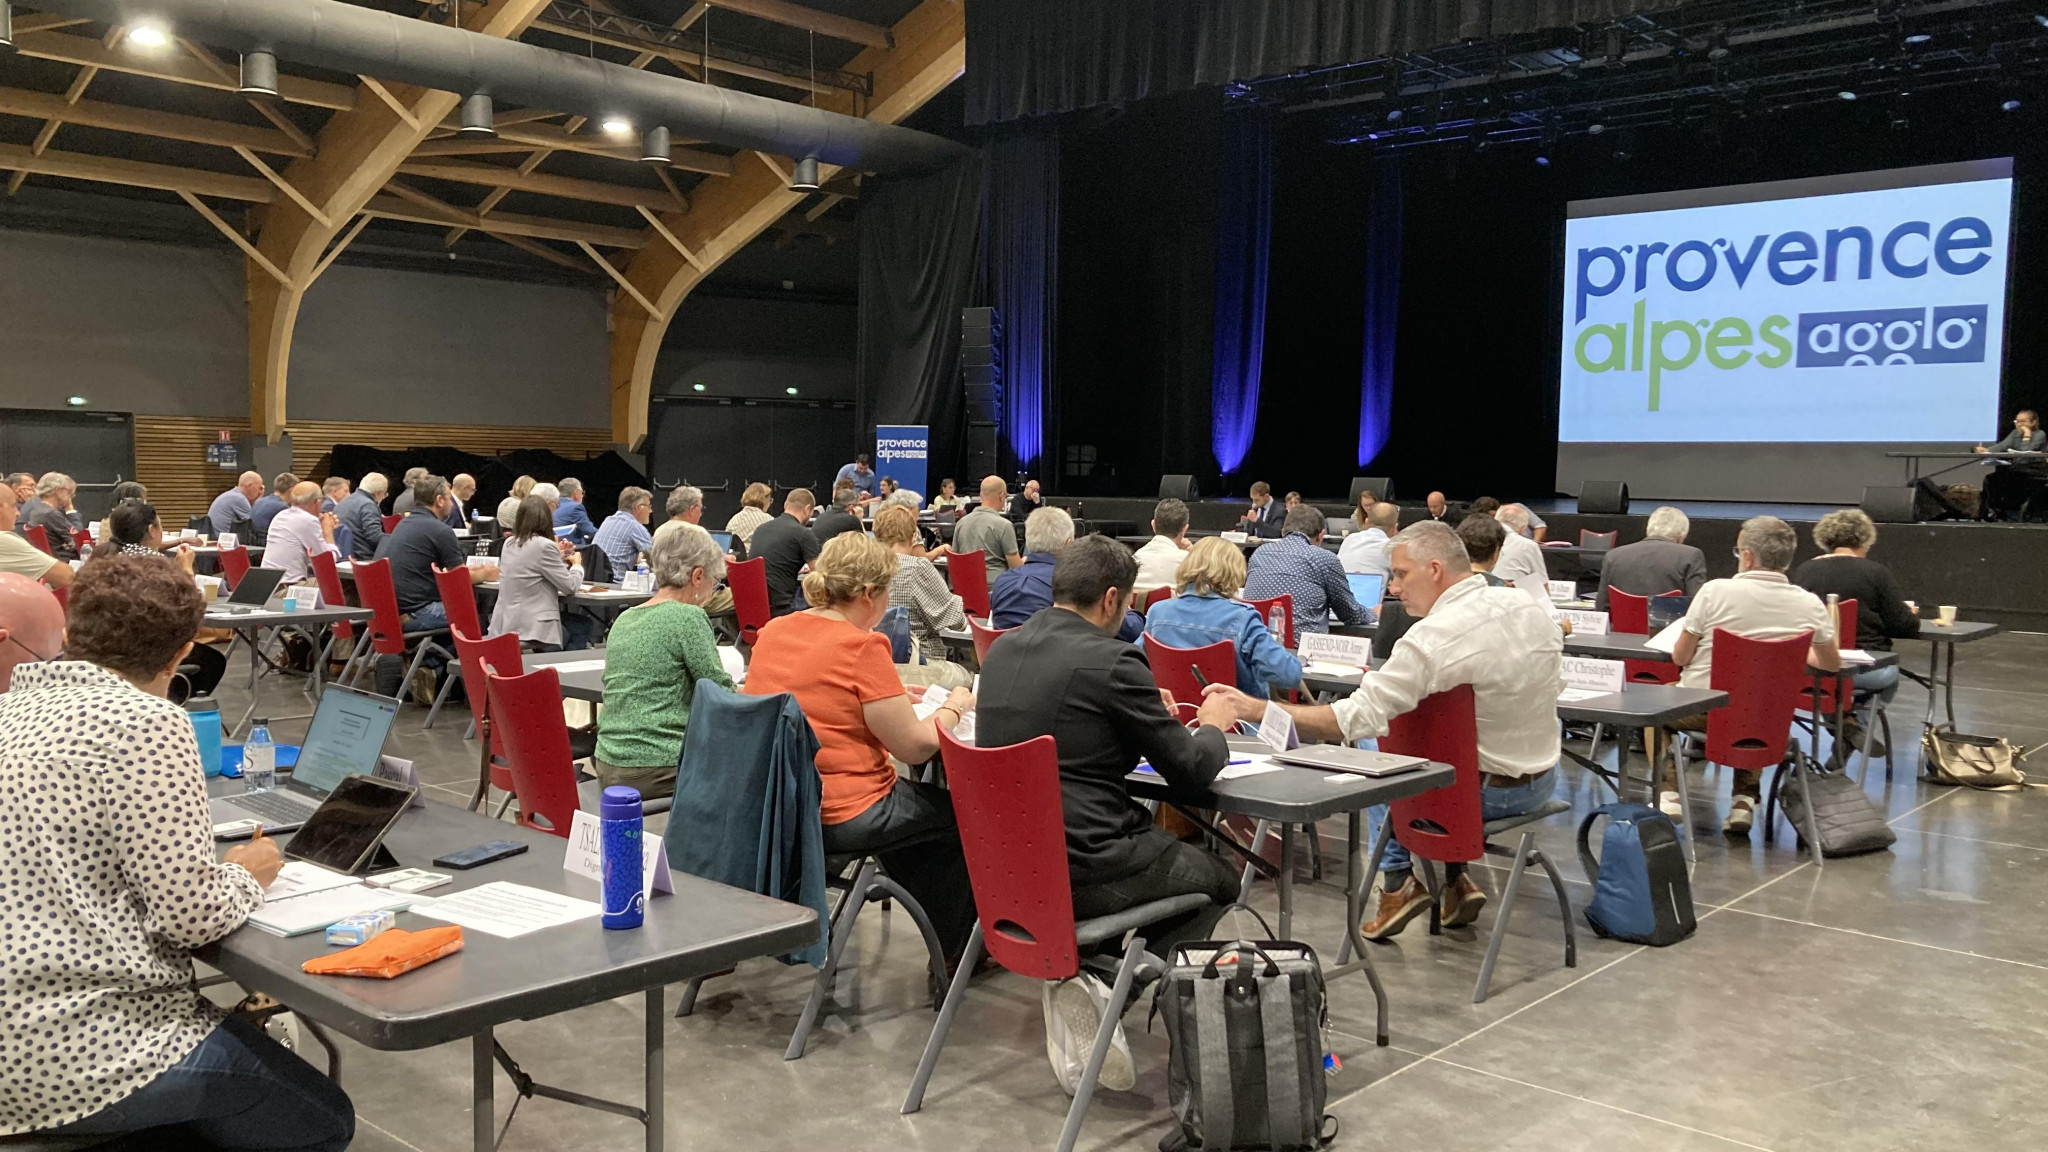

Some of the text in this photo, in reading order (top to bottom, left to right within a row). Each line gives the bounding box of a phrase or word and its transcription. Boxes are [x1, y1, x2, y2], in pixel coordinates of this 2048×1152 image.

[1575, 216, 1993, 327] provence
[1574, 297, 1978, 412] alpes agglo
[877, 439, 927, 450] provence
[877, 447, 906, 464] alpes
[1575, 661, 1616, 679] Christophe
